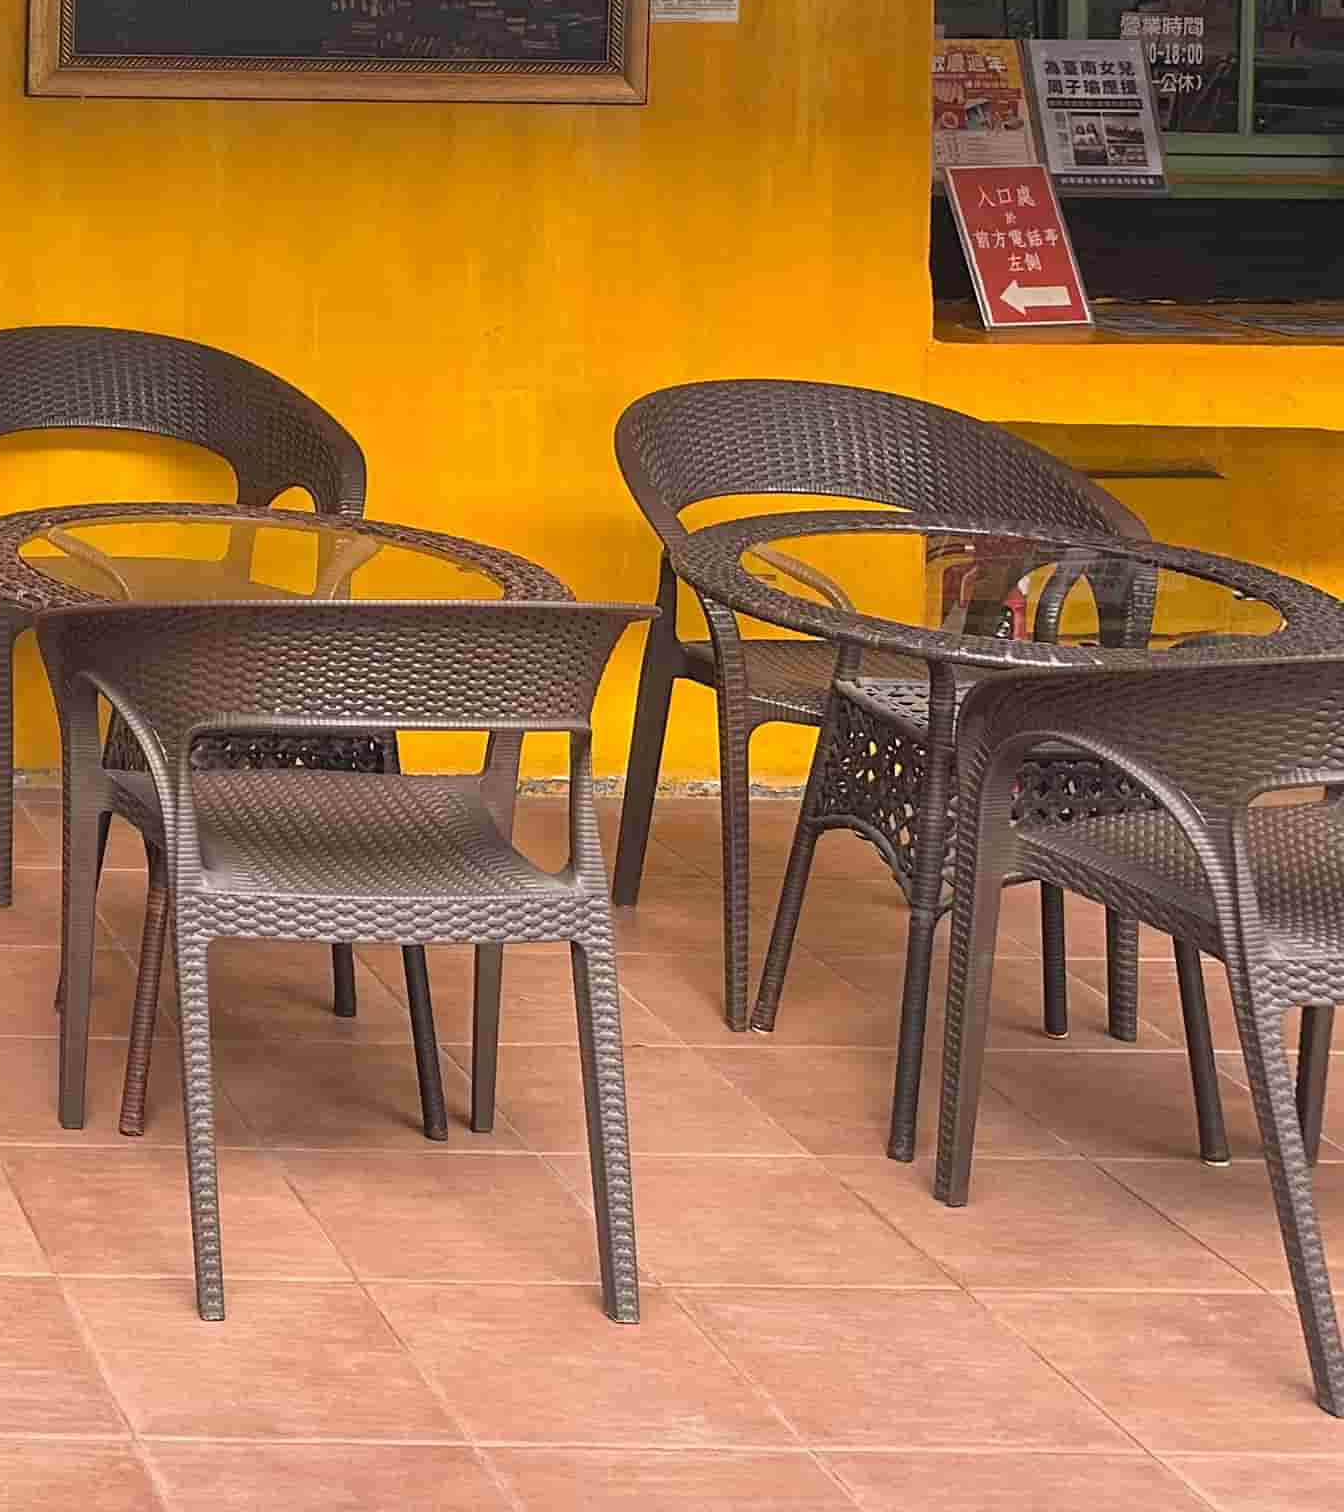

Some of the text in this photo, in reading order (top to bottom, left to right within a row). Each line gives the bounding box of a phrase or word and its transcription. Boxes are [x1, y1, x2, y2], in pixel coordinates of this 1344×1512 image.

[1145, 42, 1203, 65] 0-18:00
[977, 184, 1038, 208] 入口處
[1008, 251, 1042, 272] 左側
